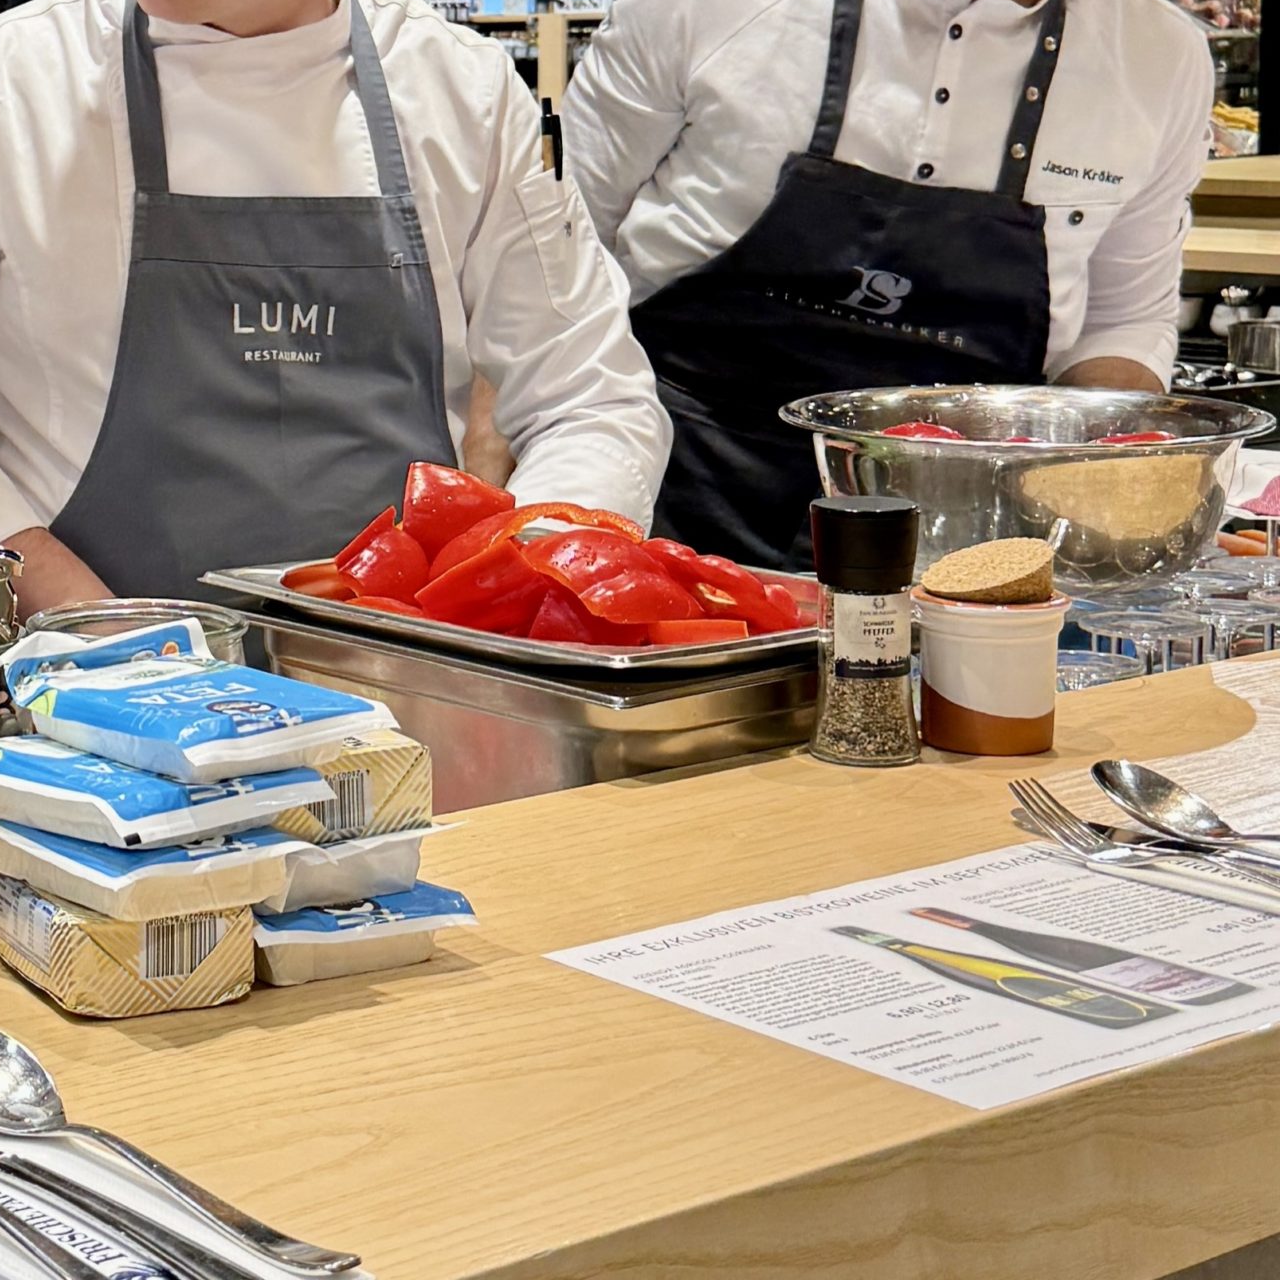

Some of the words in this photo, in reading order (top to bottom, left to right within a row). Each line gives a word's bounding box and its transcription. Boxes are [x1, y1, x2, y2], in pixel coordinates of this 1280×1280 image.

[1042, 160, 1079, 178] Jason
[233, 302, 336, 336] LUMI
[244, 349, 322, 364] RESTAURANT
[127, 682, 258, 706] FETA
[584, 947, 645, 966] IHRE
[641, 915, 776, 953] EXKLUSIVEN
[773, 883, 917, 920] BISTROWEINE
